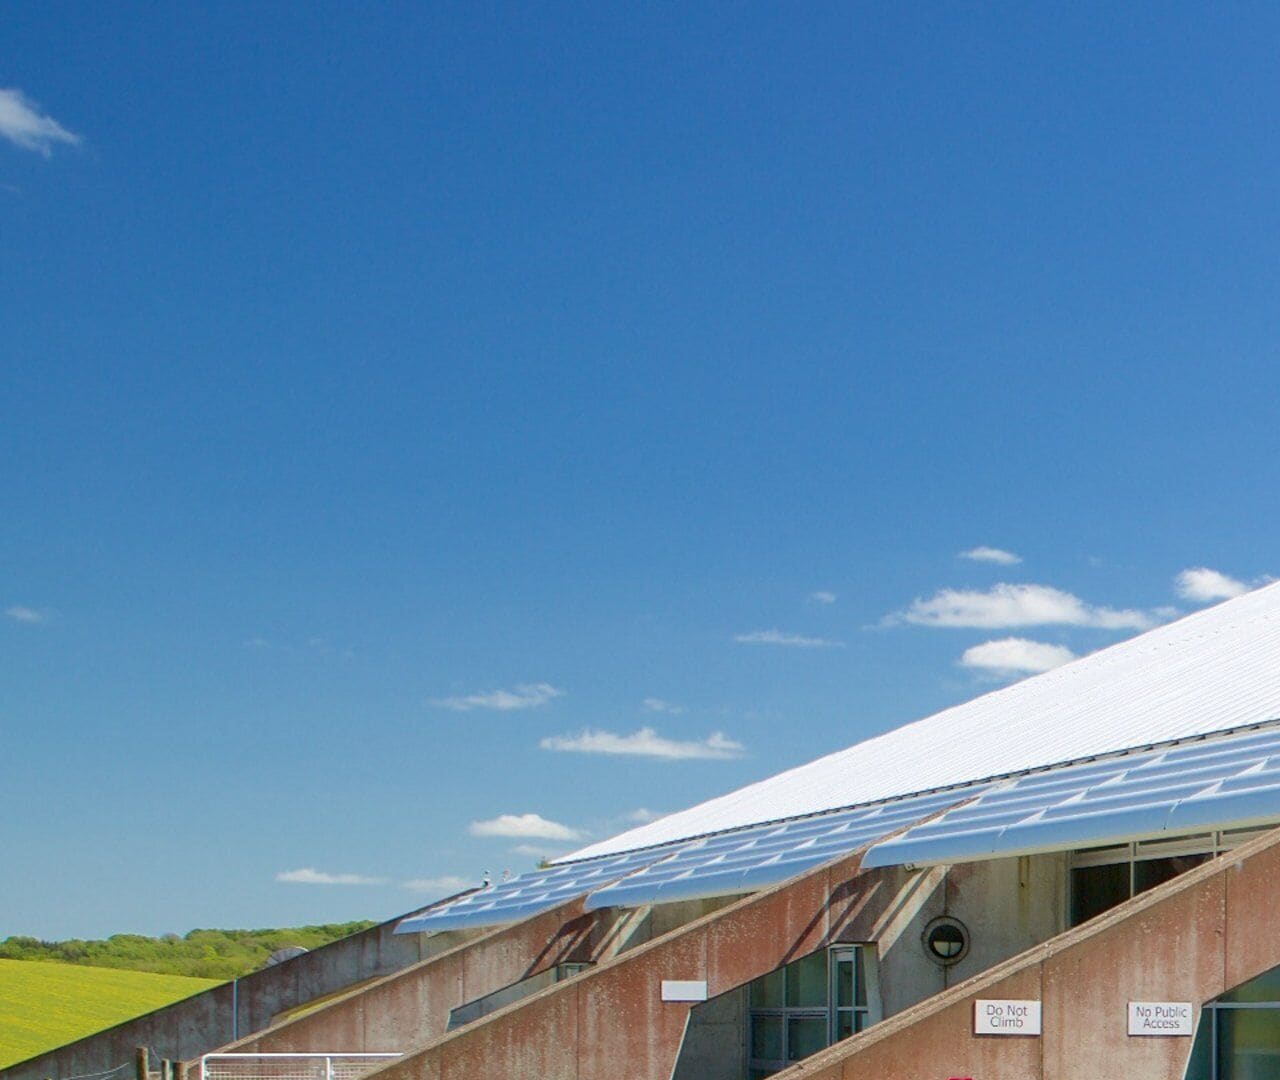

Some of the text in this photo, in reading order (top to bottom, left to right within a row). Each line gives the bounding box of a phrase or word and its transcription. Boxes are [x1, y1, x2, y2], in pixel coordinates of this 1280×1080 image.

[986, 1005, 1028, 1017] Do Not
[1136, 1006, 1187, 1018] No Public
[990, 1017, 1024, 1028] Climb
[1143, 1018, 1180, 1029] Access
